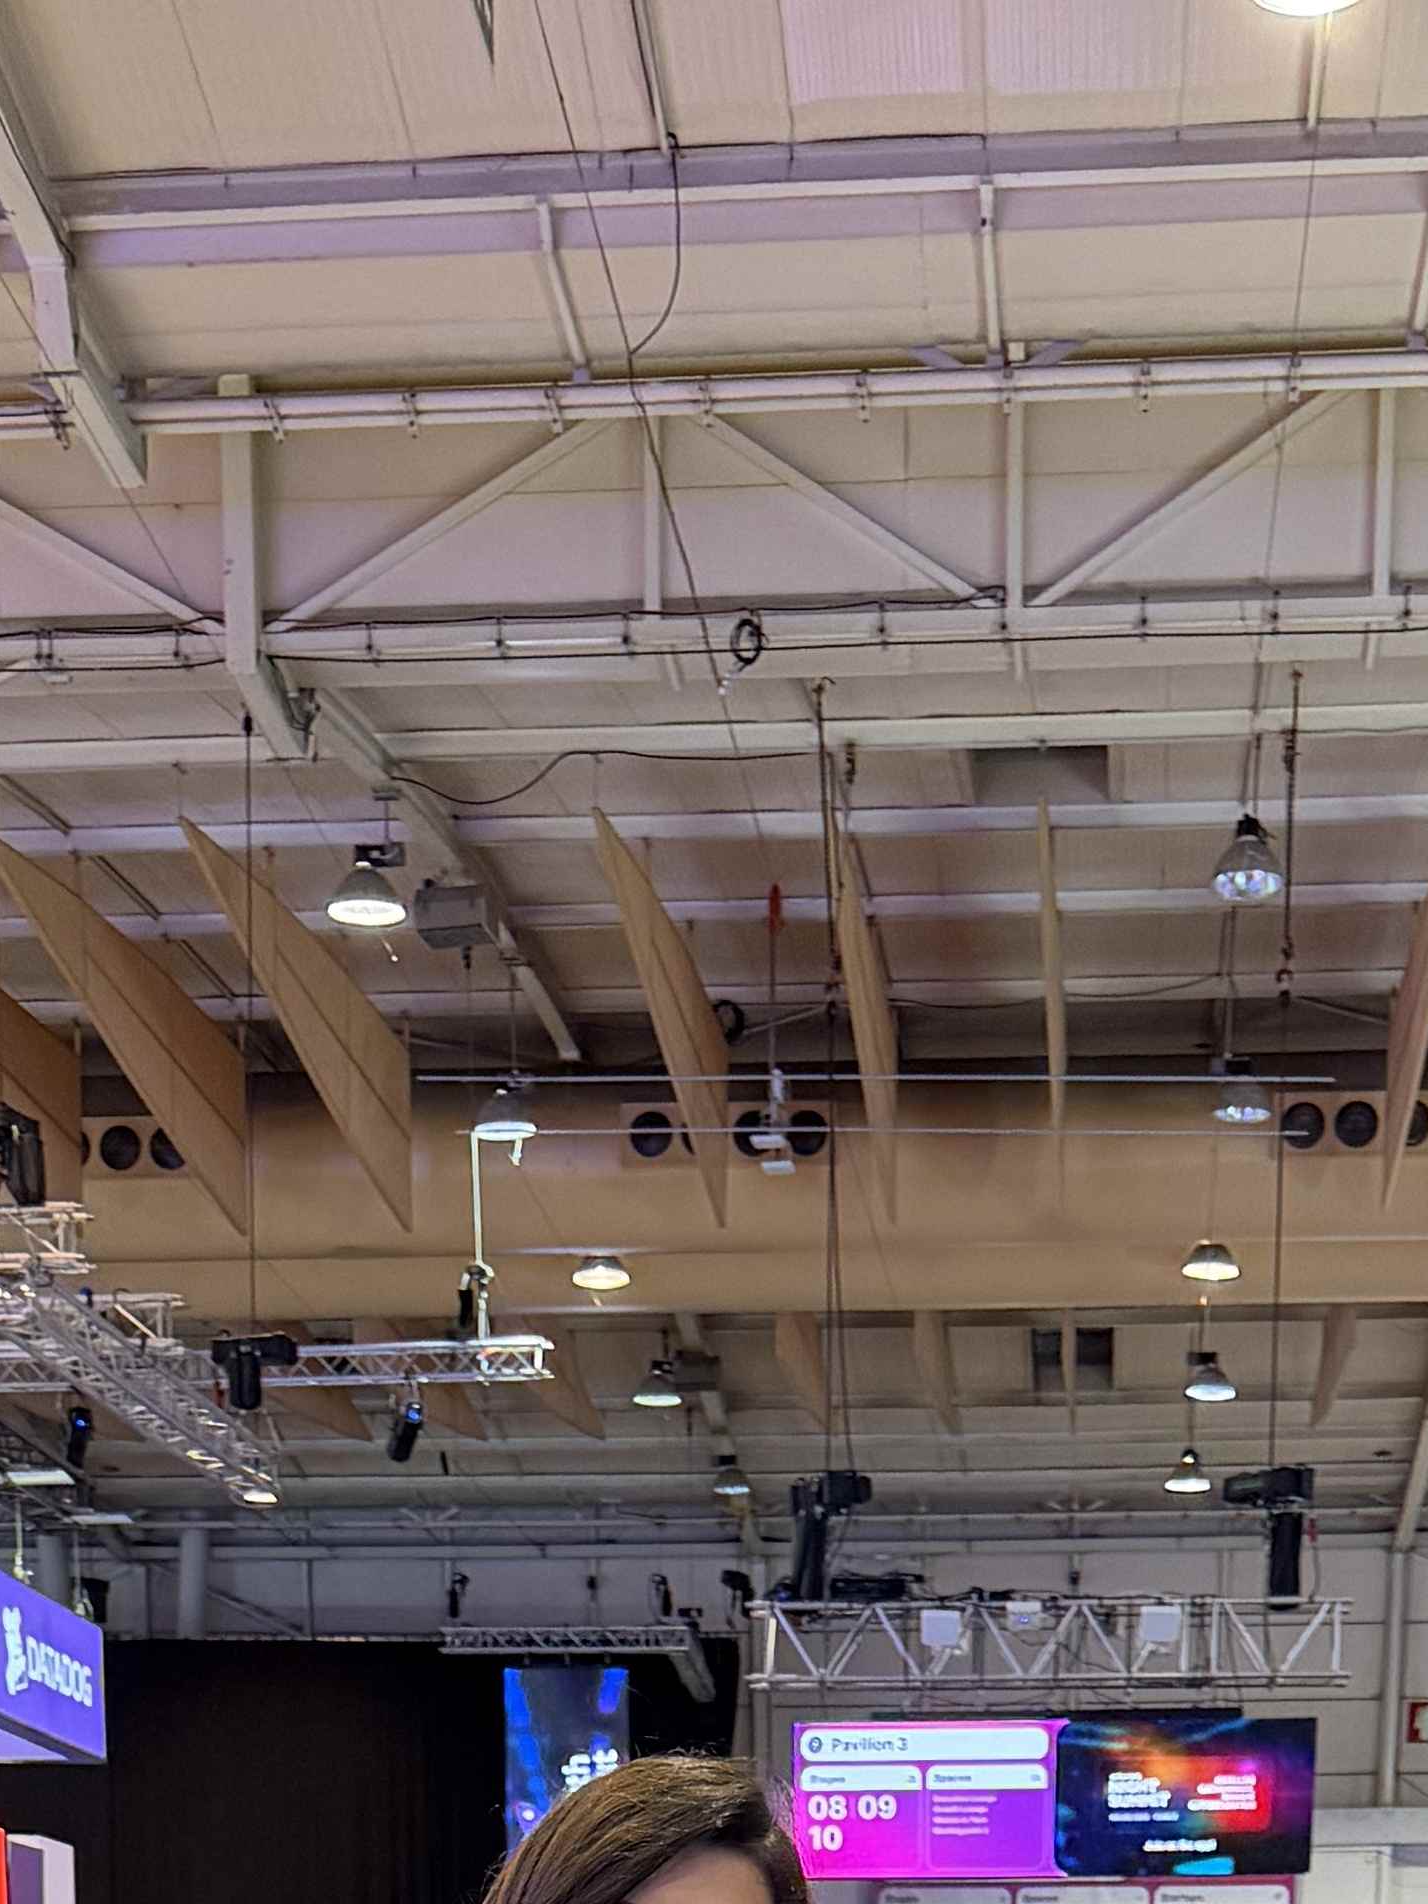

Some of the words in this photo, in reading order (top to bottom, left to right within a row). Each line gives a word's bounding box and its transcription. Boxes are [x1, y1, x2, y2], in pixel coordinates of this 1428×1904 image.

[25, 1634, 93, 1708] DATADOG
[831, 1737, 895, 1752] Pavilion
[898, 1737, 909, 1751] 3
[807, 1794, 848, 1821] 08
[857, 1794, 898, 1820] 09
[807, 1824, 844, 1852] 10
